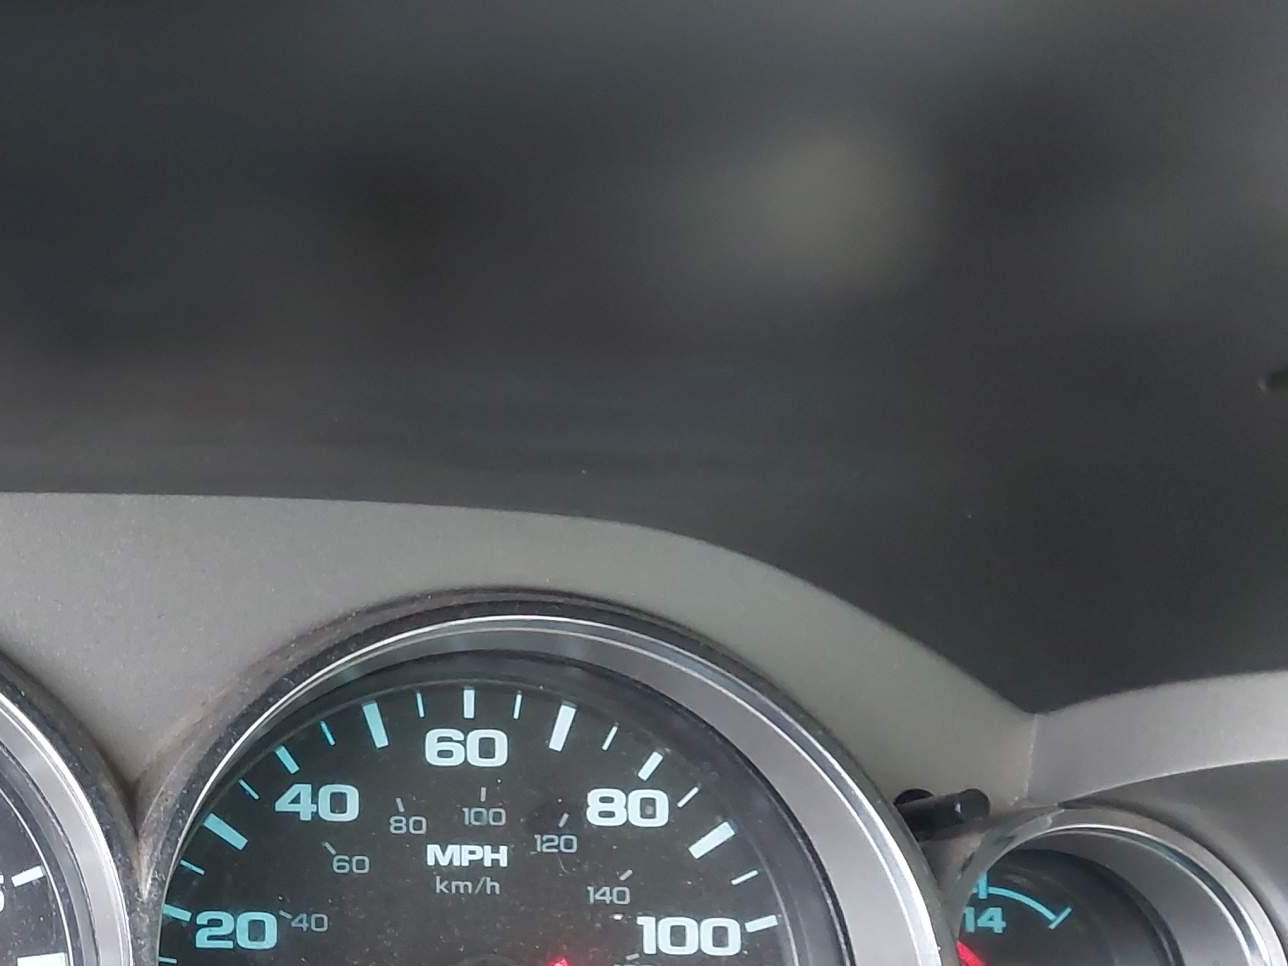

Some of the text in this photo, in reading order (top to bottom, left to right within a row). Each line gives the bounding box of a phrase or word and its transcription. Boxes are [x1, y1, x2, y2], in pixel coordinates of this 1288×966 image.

[425, 728, 508, 767] 60
[275, 783, 359, 822] 40
[586, 788, 669, 827] 80
[389, 816, 427, 834] 80
[462, 807, 506, 826] 100
[534, 834, 577, 853] 120
[332, 855, 370, 874] 60
[426, 844, 509, 867] MPH
[435, 876, 501, 895] km/h
[587, 886, 631, 905] 140
[195, 911, 278, 950] 20
[291, 913, 329, 932] 40
[963, 907, 1007, 933] 14
[636, 916, 742, 956] 100
